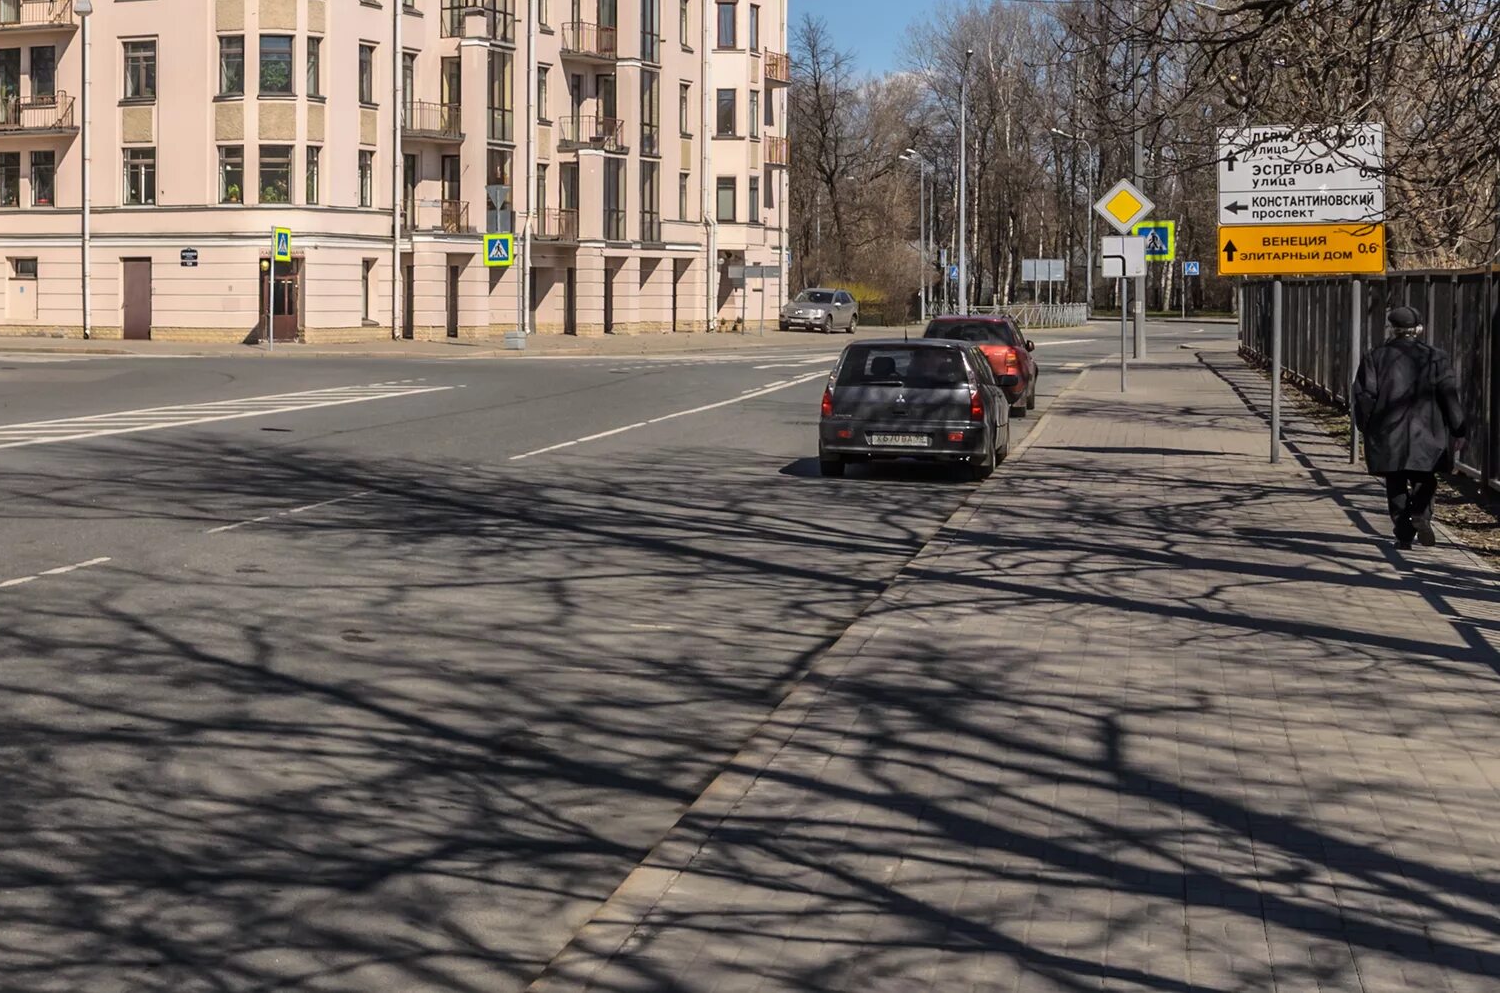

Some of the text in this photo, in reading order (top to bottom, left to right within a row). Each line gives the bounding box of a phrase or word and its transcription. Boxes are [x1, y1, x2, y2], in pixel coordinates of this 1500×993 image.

[1358, 135, 1375, 146] 0.1
[1253, 145, 1288, 157] улица
[1252, 163, 1335, 175] ЭСПЕРОВА
[1252, 178, 1296, 189] улица
[1252, 192, 1375, 207] КОНСТАНТИНОВСКИЙ
[1252, 210, 1315, 220] проспект
[1262, 236, 1327, 247] ВЕНЕЦИЯ
[1240, 251, 1353, 261] ЭЛИТАРНЫЙ ДОМ
